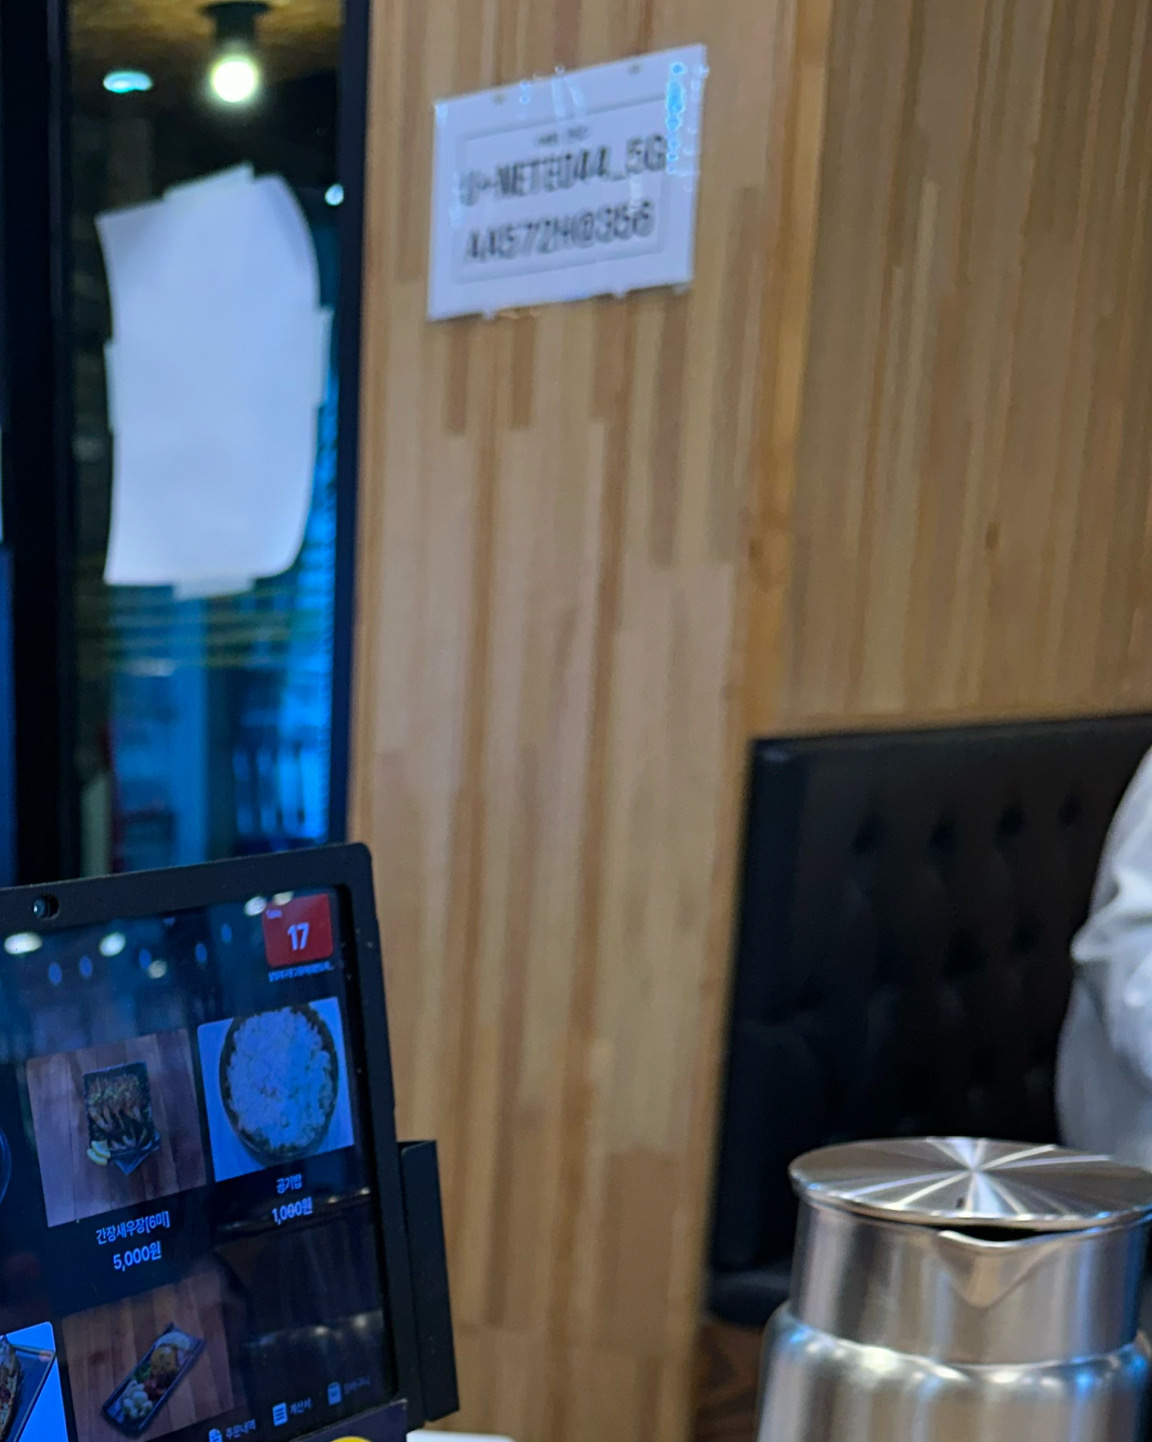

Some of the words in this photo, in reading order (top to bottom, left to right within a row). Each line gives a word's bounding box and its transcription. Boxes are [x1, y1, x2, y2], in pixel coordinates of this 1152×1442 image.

[287, 922, 309, 951] 17
[272, 1197, 313, 1225] 1,000원
[112, 1240, 162, 1272] 5,000원
